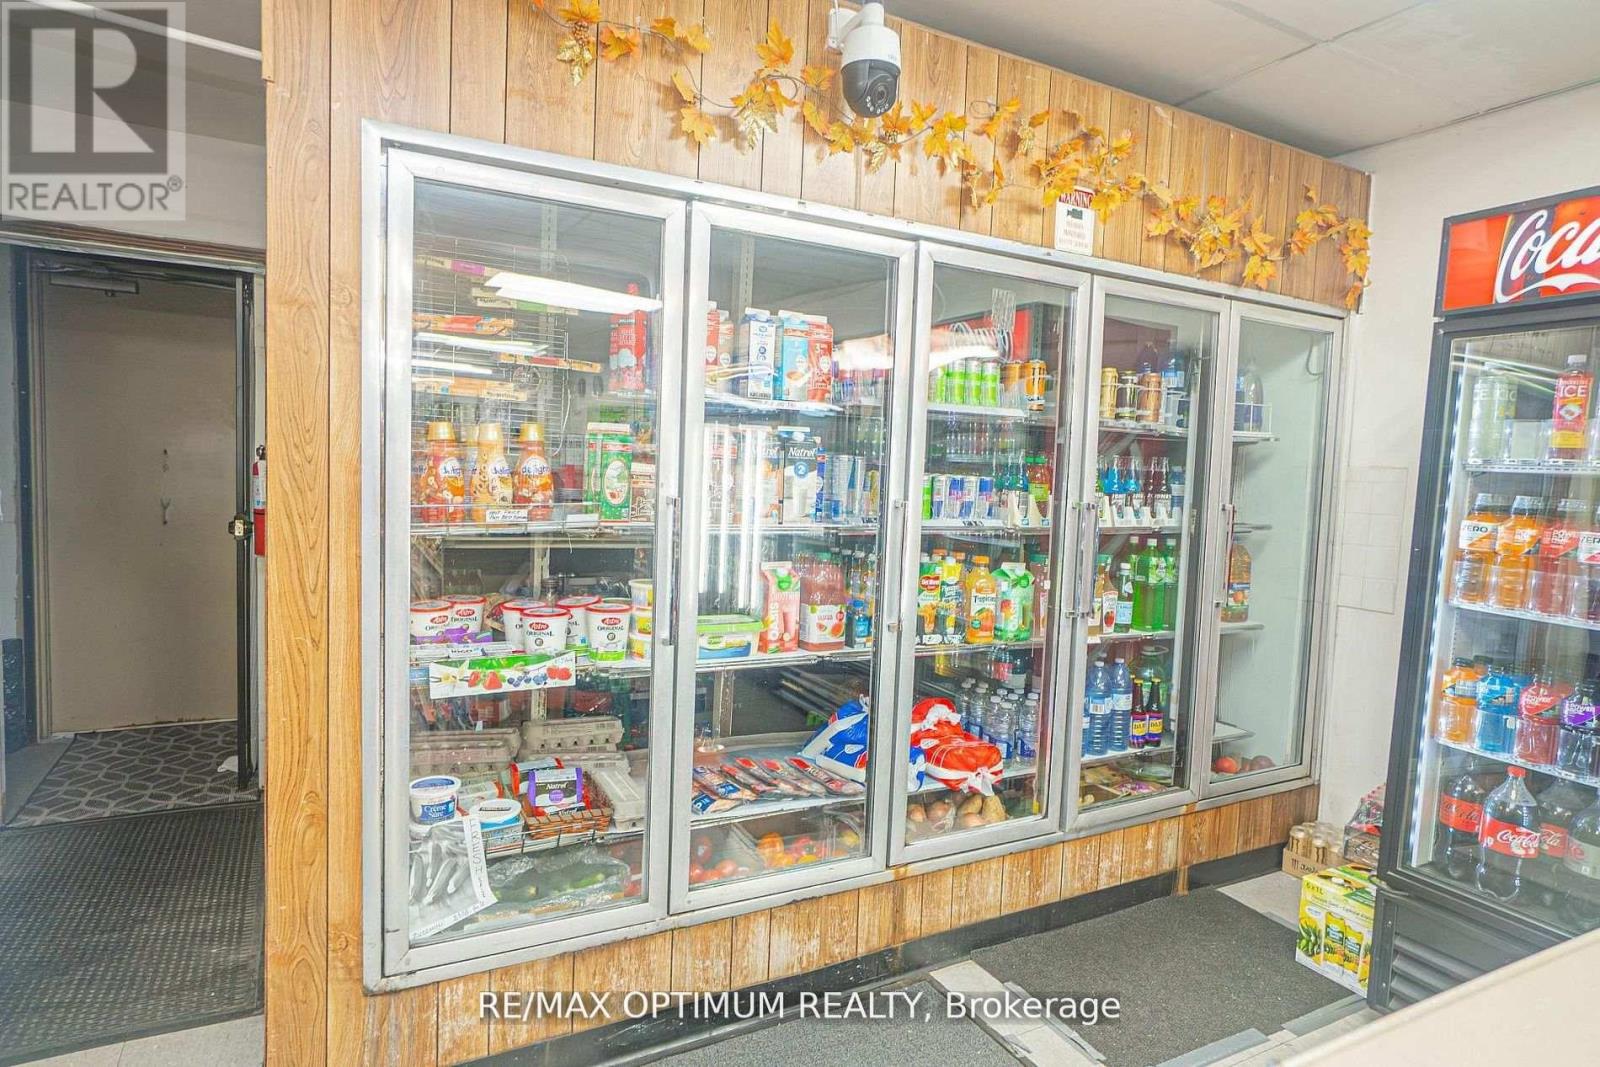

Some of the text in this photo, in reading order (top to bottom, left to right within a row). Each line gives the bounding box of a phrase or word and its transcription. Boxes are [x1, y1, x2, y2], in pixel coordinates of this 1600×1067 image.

[1559, 385, 1587, 398] ICE
[787, 446, 816, 457] Natrel
[798, 464, 806, 473] 2
[546, 781, 569, 790] Natrel
